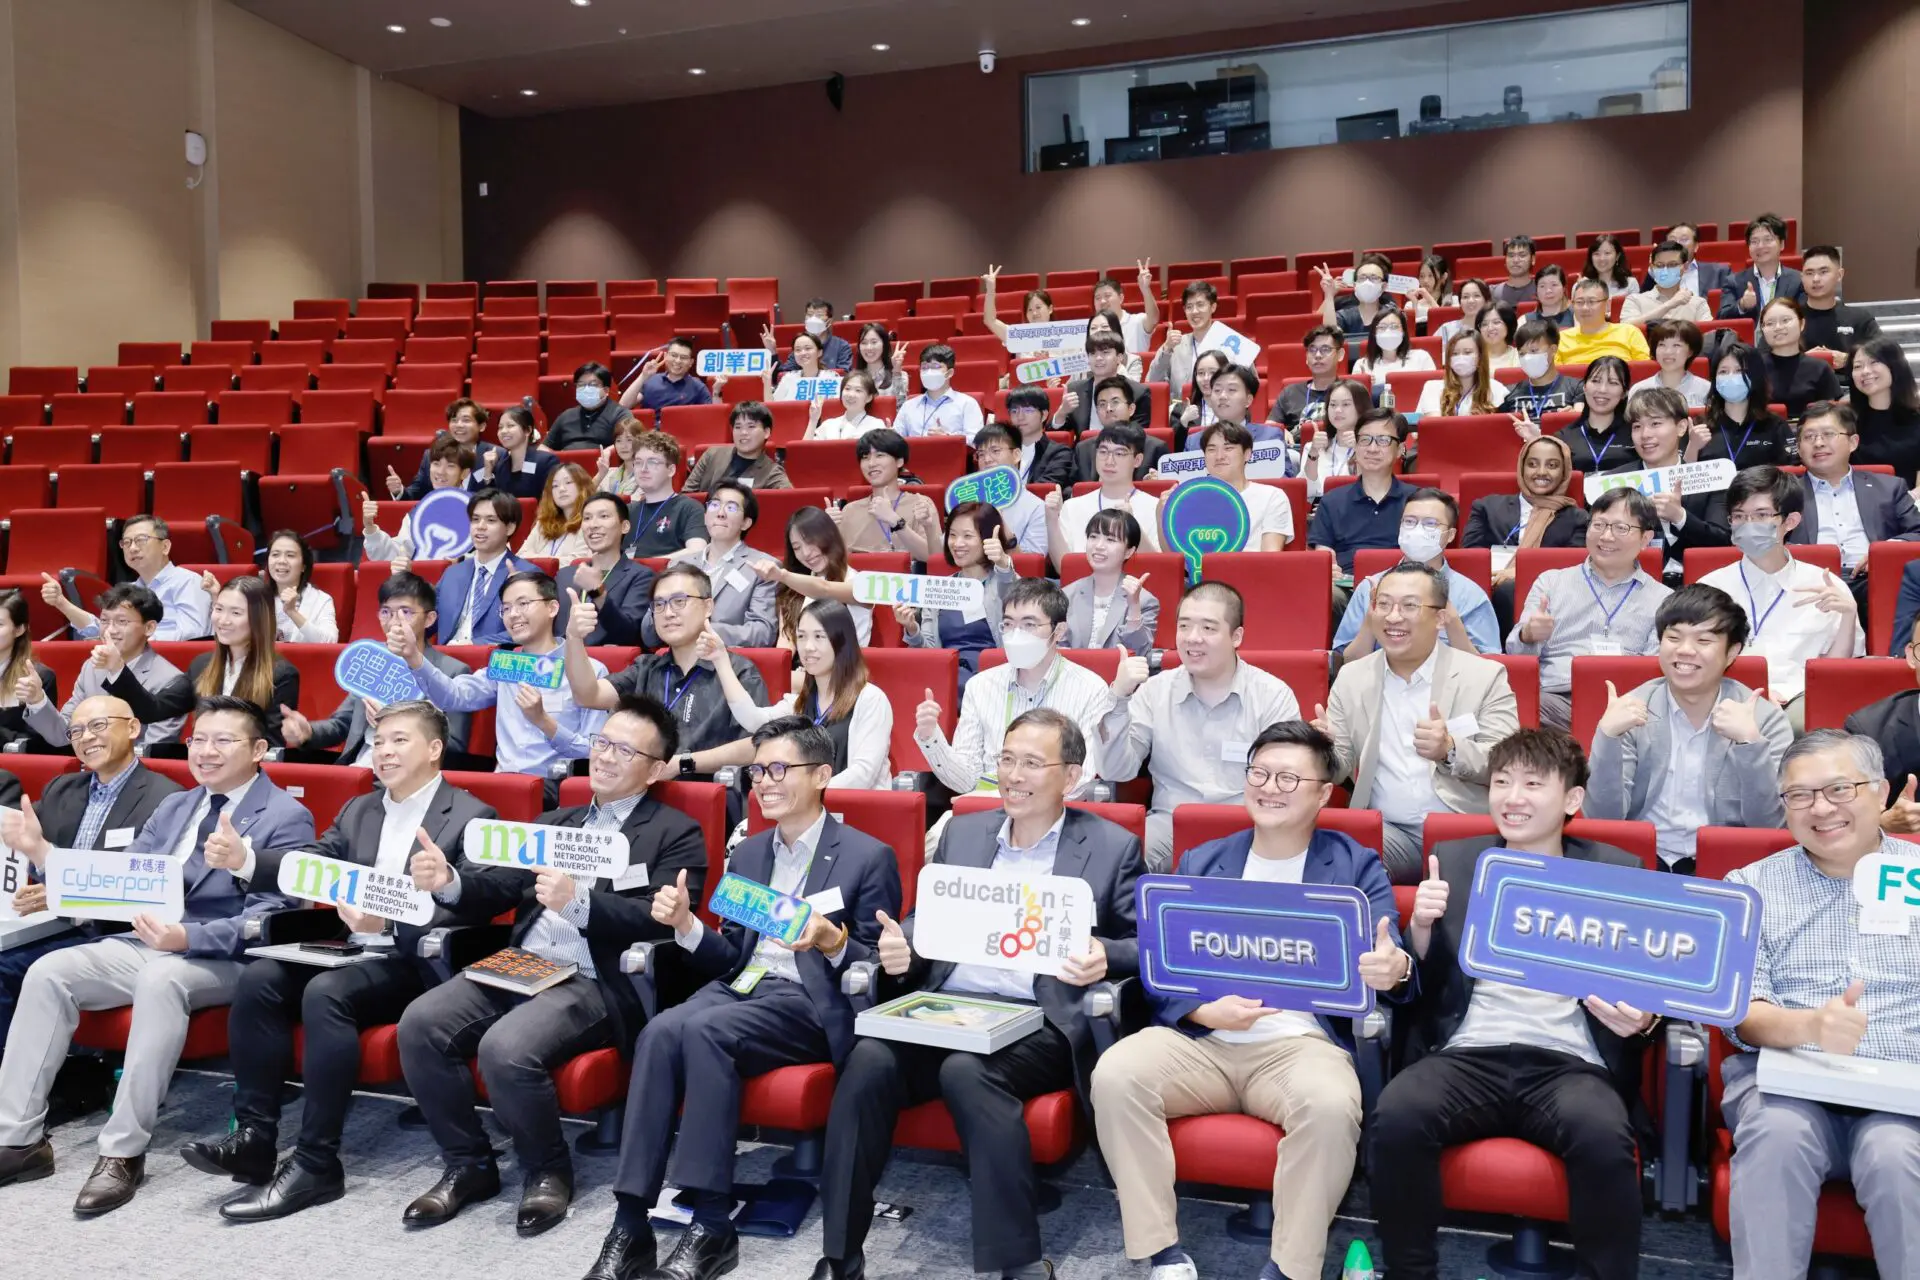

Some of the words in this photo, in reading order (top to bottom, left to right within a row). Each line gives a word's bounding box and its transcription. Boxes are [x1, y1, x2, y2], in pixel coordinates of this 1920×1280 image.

[703, 351, 765, 373] 創業日
[795, 379, 838, 401] 創業
[1668, 461, 1720, 475] 香港都會大學
[1690, 471, 1710, 480] KONG
[1669, 475, 1723, 489] MROPOLITAN
[924, 593, 971, 602] METROPOLITAN
[924, 599, 959, 607] UNIVERSITY
[343, 646, 414, 703] 體驗
[555, 830, 613, 846] 香港都會大學
[554, 843, 576, 853] HONG
[577, 845, 599, 854] KONG
[129, 857, 167, 874] 數碼港
[553, 860, 598, 872] UNIVERSITY
[554, 852, 612, 865] METROPOLITAN
[62, 864, 169, 901] Cyberport
[368, 872, 421, 893] 香港都會大
[365, 884, 388, 896] HONG
[387, 889, 408, 900] KONG
[362, 902, 405, 917] UNIVERSITY
[363, 892, 419, 912] METROPOLITAN
[1014, 906, 1053, 932] for
[1057, 893, 1074, 959] 仁人學社
[1513, 906, 1697, 962] START-UP
[985, 928, 1050, 958] good
[1190, 931, 1318, 966] FOUNDER
